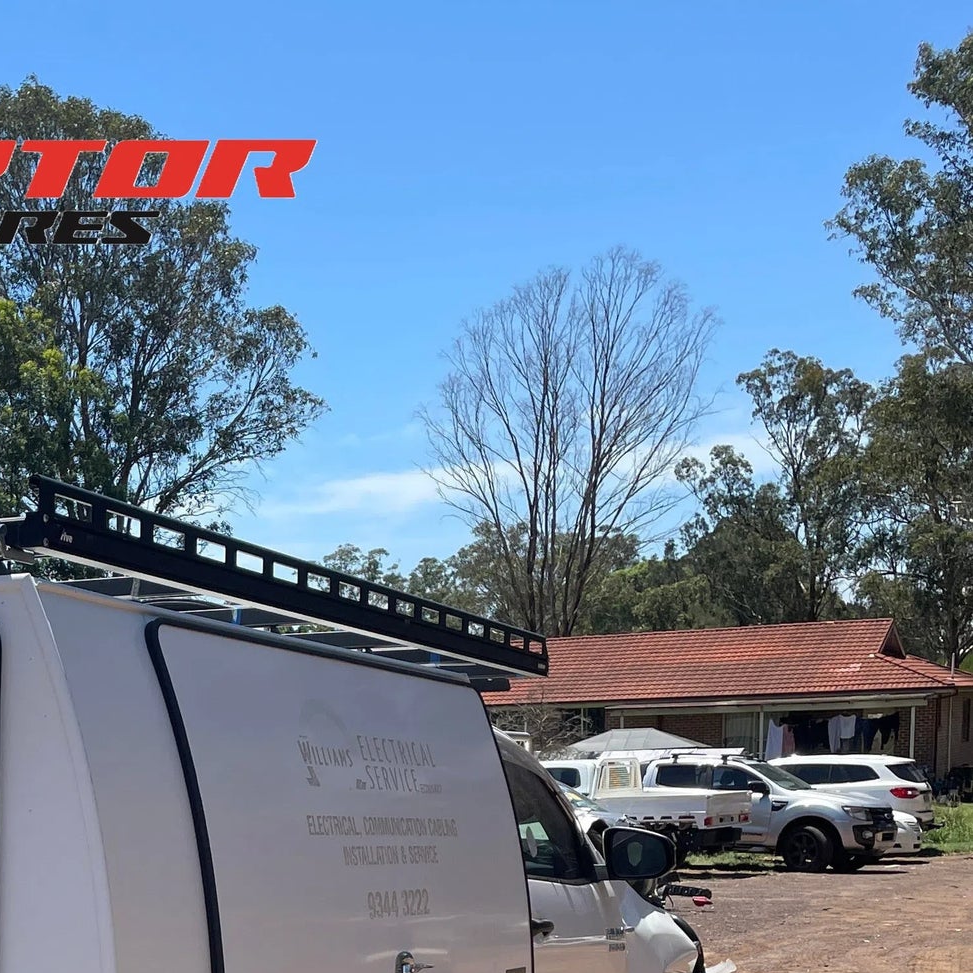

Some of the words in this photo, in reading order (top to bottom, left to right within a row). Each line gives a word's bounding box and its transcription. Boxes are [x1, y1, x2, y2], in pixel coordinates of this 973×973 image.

[356, 735, 436, 768] ELECTRICAL
[365, 764, 420, 793] SERVICE
[306, 814, 363, 838] ELECTRICAL,
[342, 845, 400, 866] INSTALLATION
[367, 892, 398, 920] 9344
[401, 888, 431, 917] 3222
